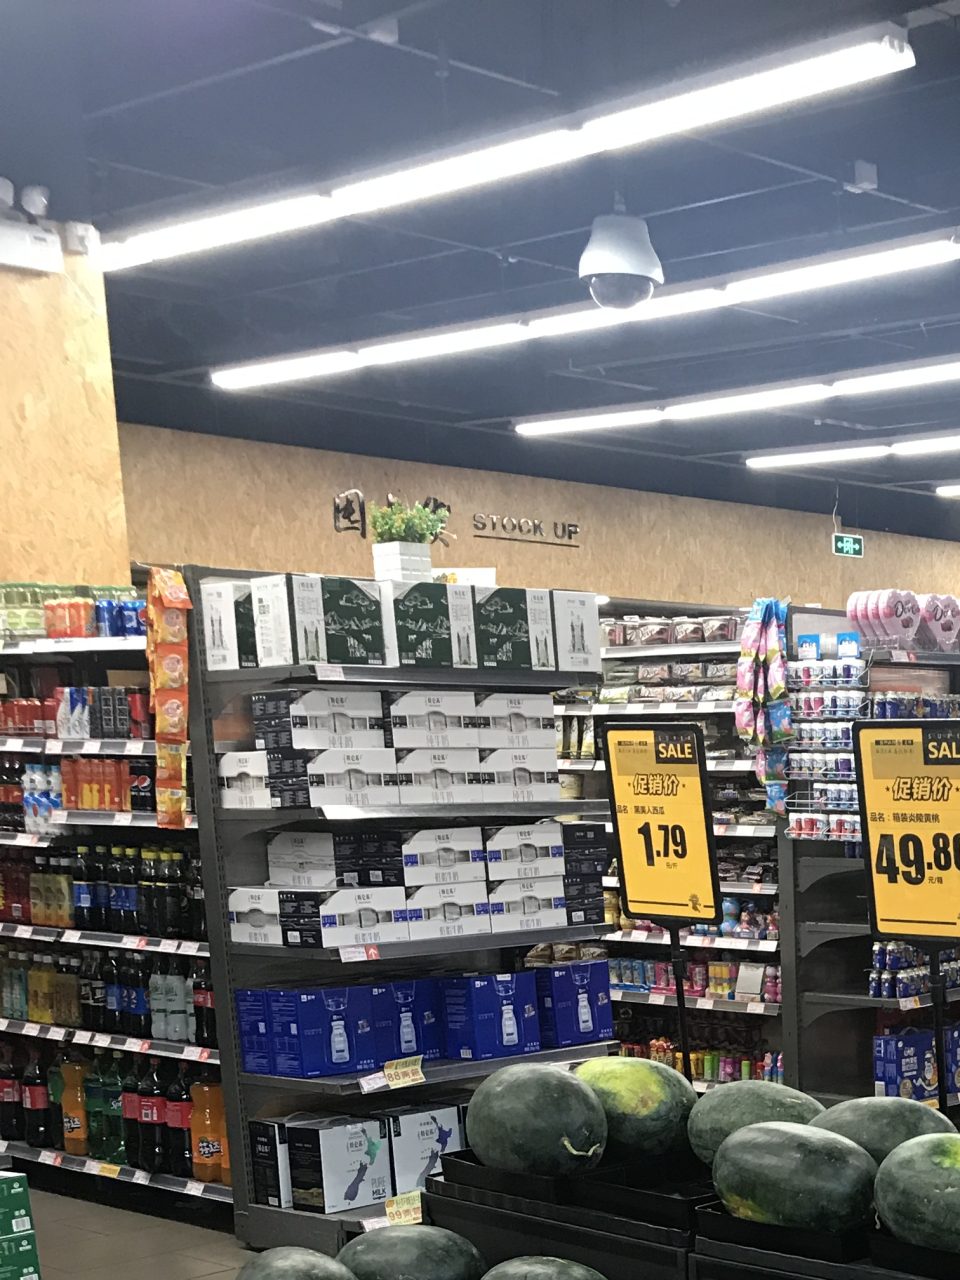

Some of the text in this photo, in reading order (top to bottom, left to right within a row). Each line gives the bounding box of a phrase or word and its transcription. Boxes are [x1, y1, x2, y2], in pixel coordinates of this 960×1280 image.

[473, 513, 580, 540] STOCK UP
[894, 601, 918, 618] Dove
[659, 743, 693, 758] SALE
[633, 773, 679, 796] 促销价
[892, 776, 953, 802] 促销价
[637, 822, 688, 867] 1.79
[371, 1175, 386, 1186] PURE
[372, 1188, 386, 1196] MILK
